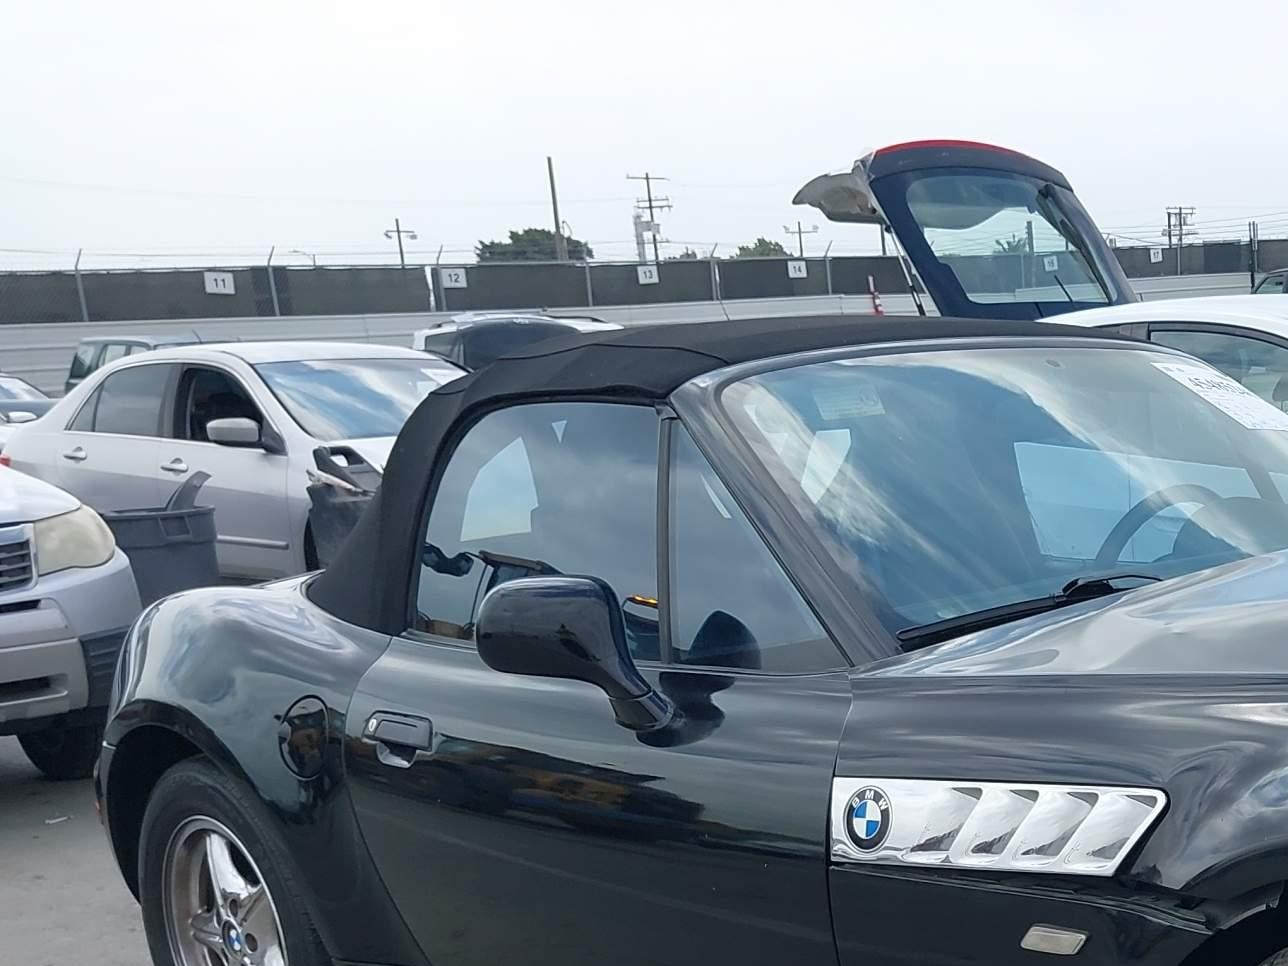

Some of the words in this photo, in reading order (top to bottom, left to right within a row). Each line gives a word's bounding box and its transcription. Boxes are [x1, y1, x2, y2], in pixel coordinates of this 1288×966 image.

[448, 272, 461, 283] 12
[643, 269, 654, 279] 13
[213, 277, 226, 289] 11
[851, 789, 889, 812] BMW
